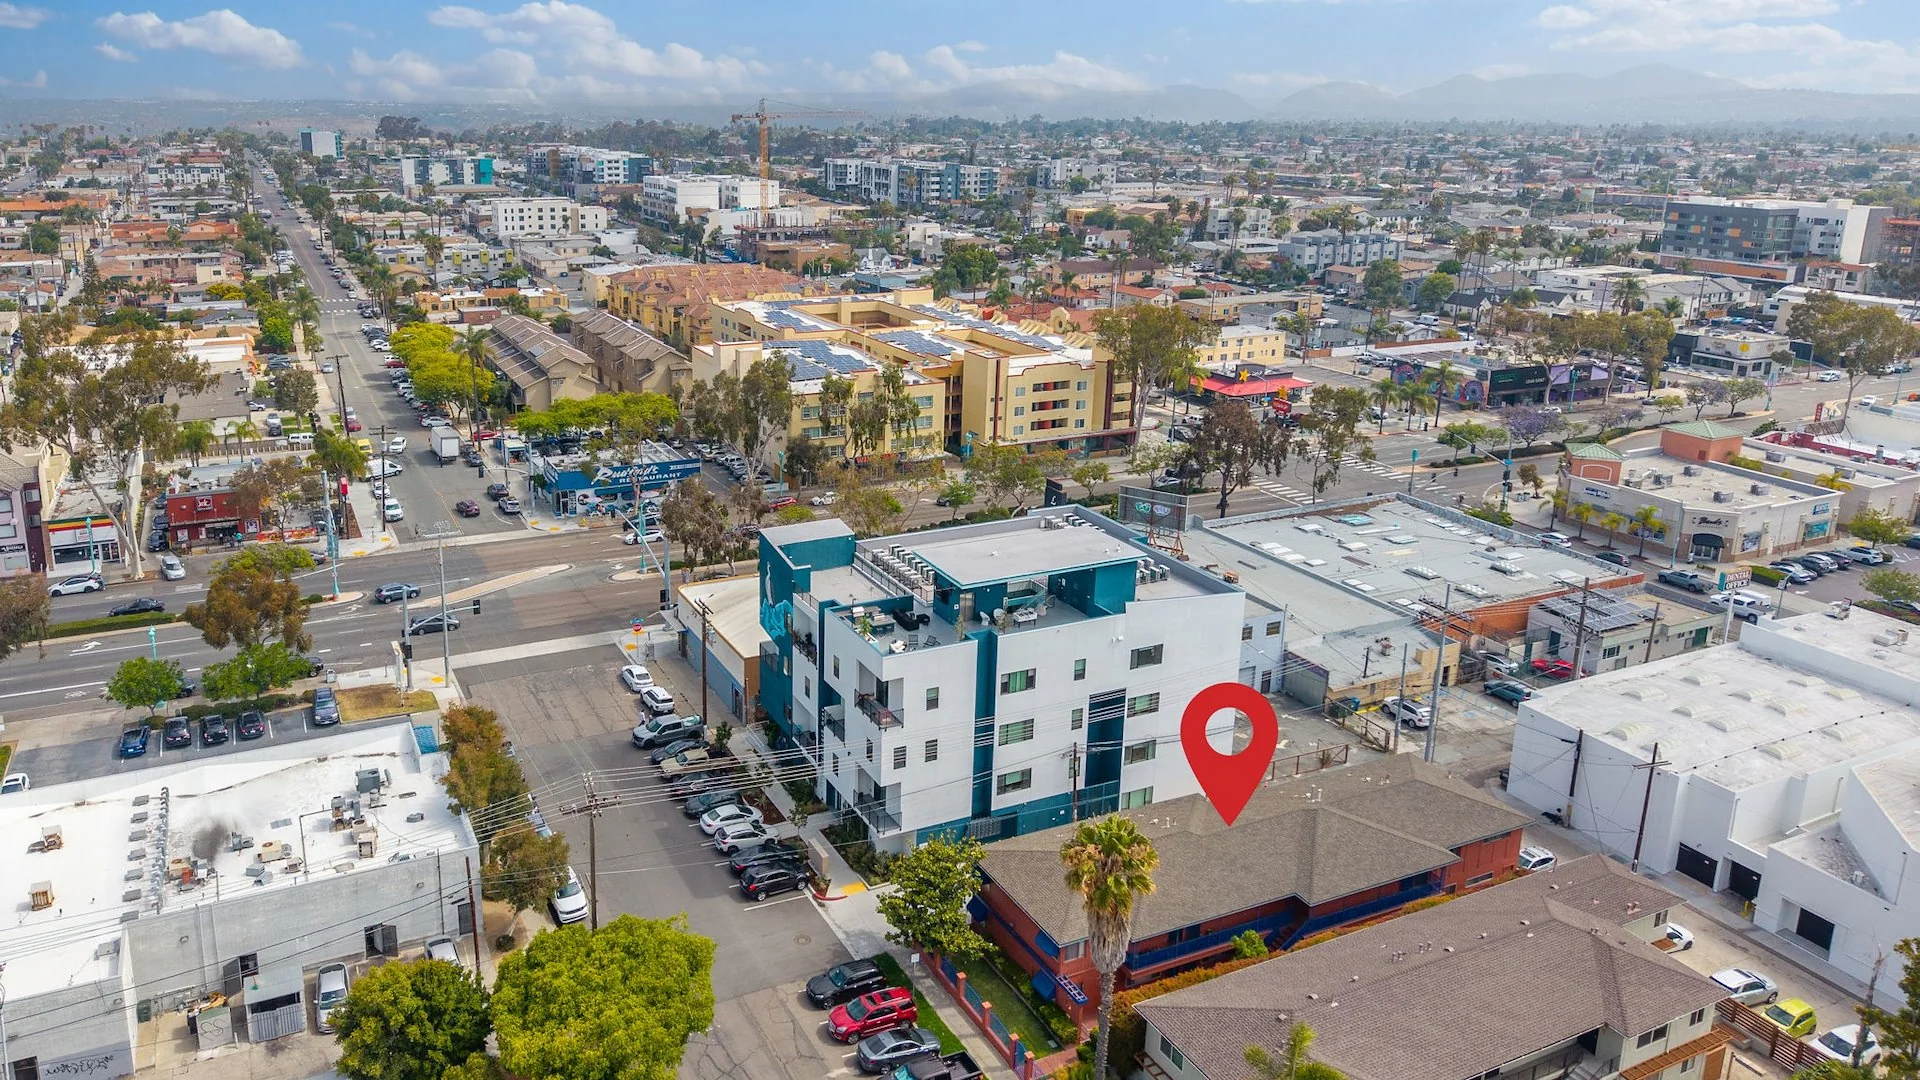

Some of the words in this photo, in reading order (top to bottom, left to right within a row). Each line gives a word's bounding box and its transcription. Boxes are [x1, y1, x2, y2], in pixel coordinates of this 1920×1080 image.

[619, 472, 681, 484] RETAURANT
[1726, 570, 1751, 581] DENTAL
[1725, 579, 1749, 590] OFFICE
